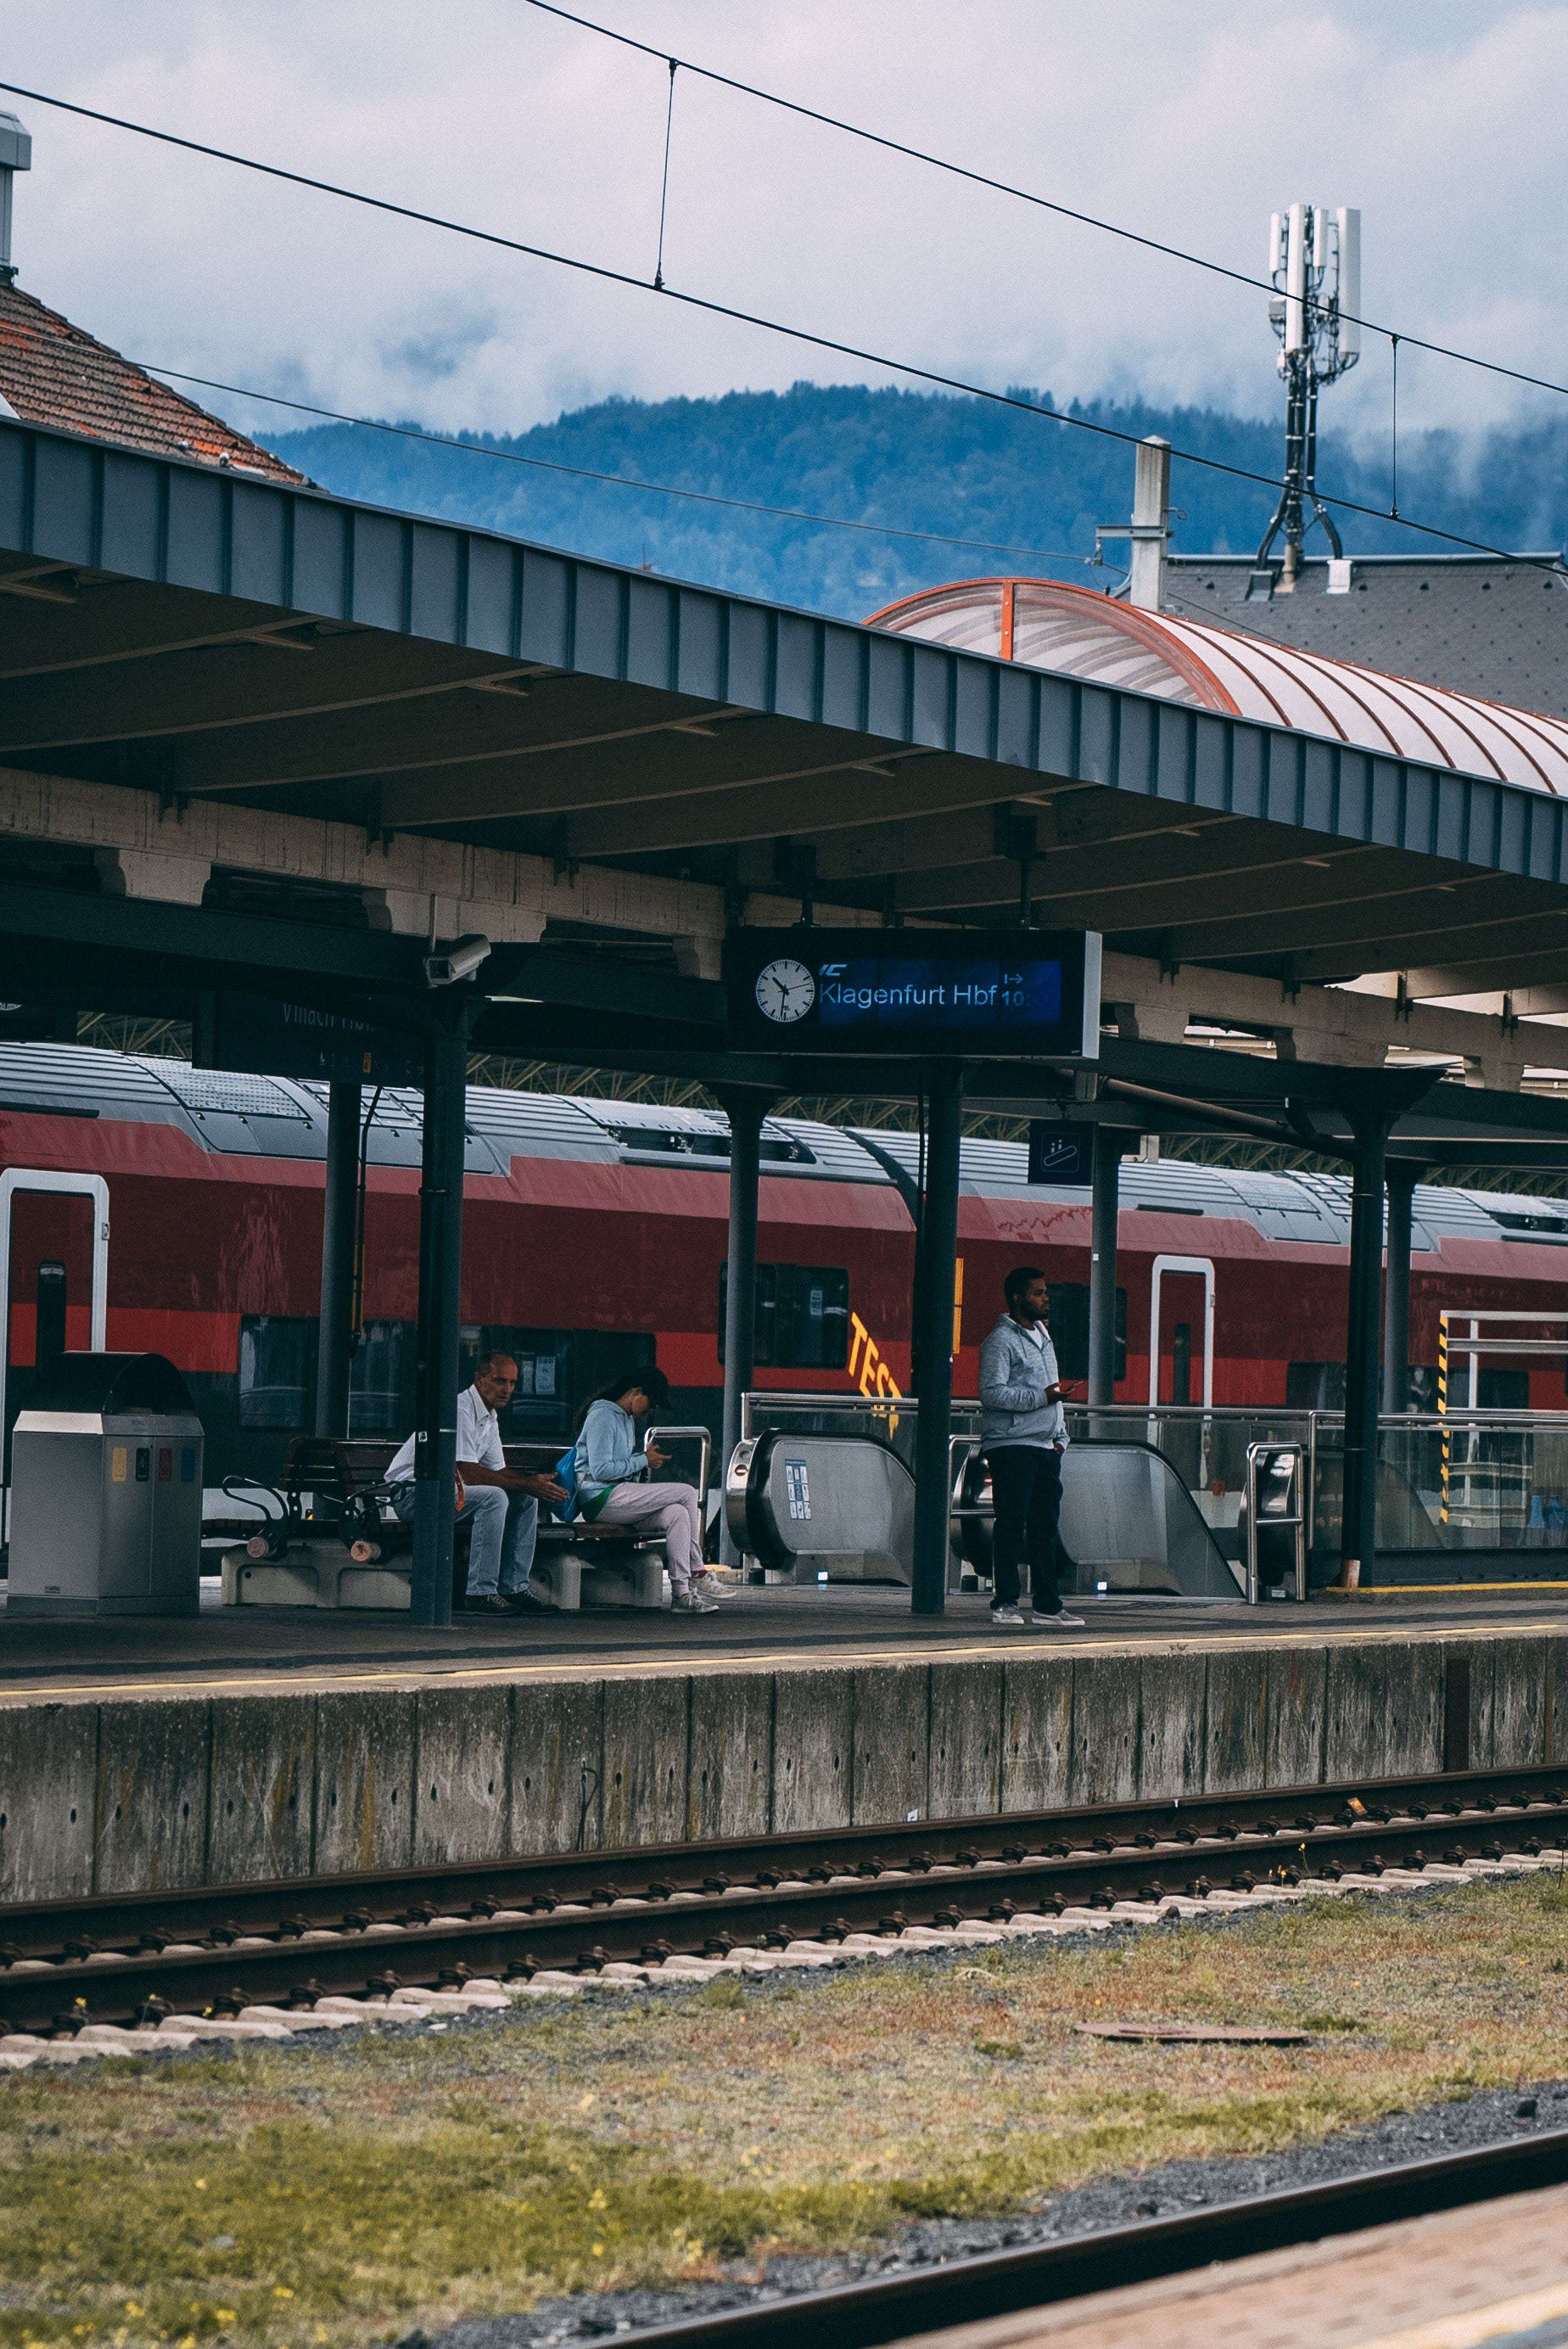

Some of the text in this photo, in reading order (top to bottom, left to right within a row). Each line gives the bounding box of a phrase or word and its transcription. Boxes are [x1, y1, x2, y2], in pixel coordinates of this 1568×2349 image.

[820, 984, 997, 1009] Klagenfurt Hbf
[848, 1311, 902, 1441] TEST
